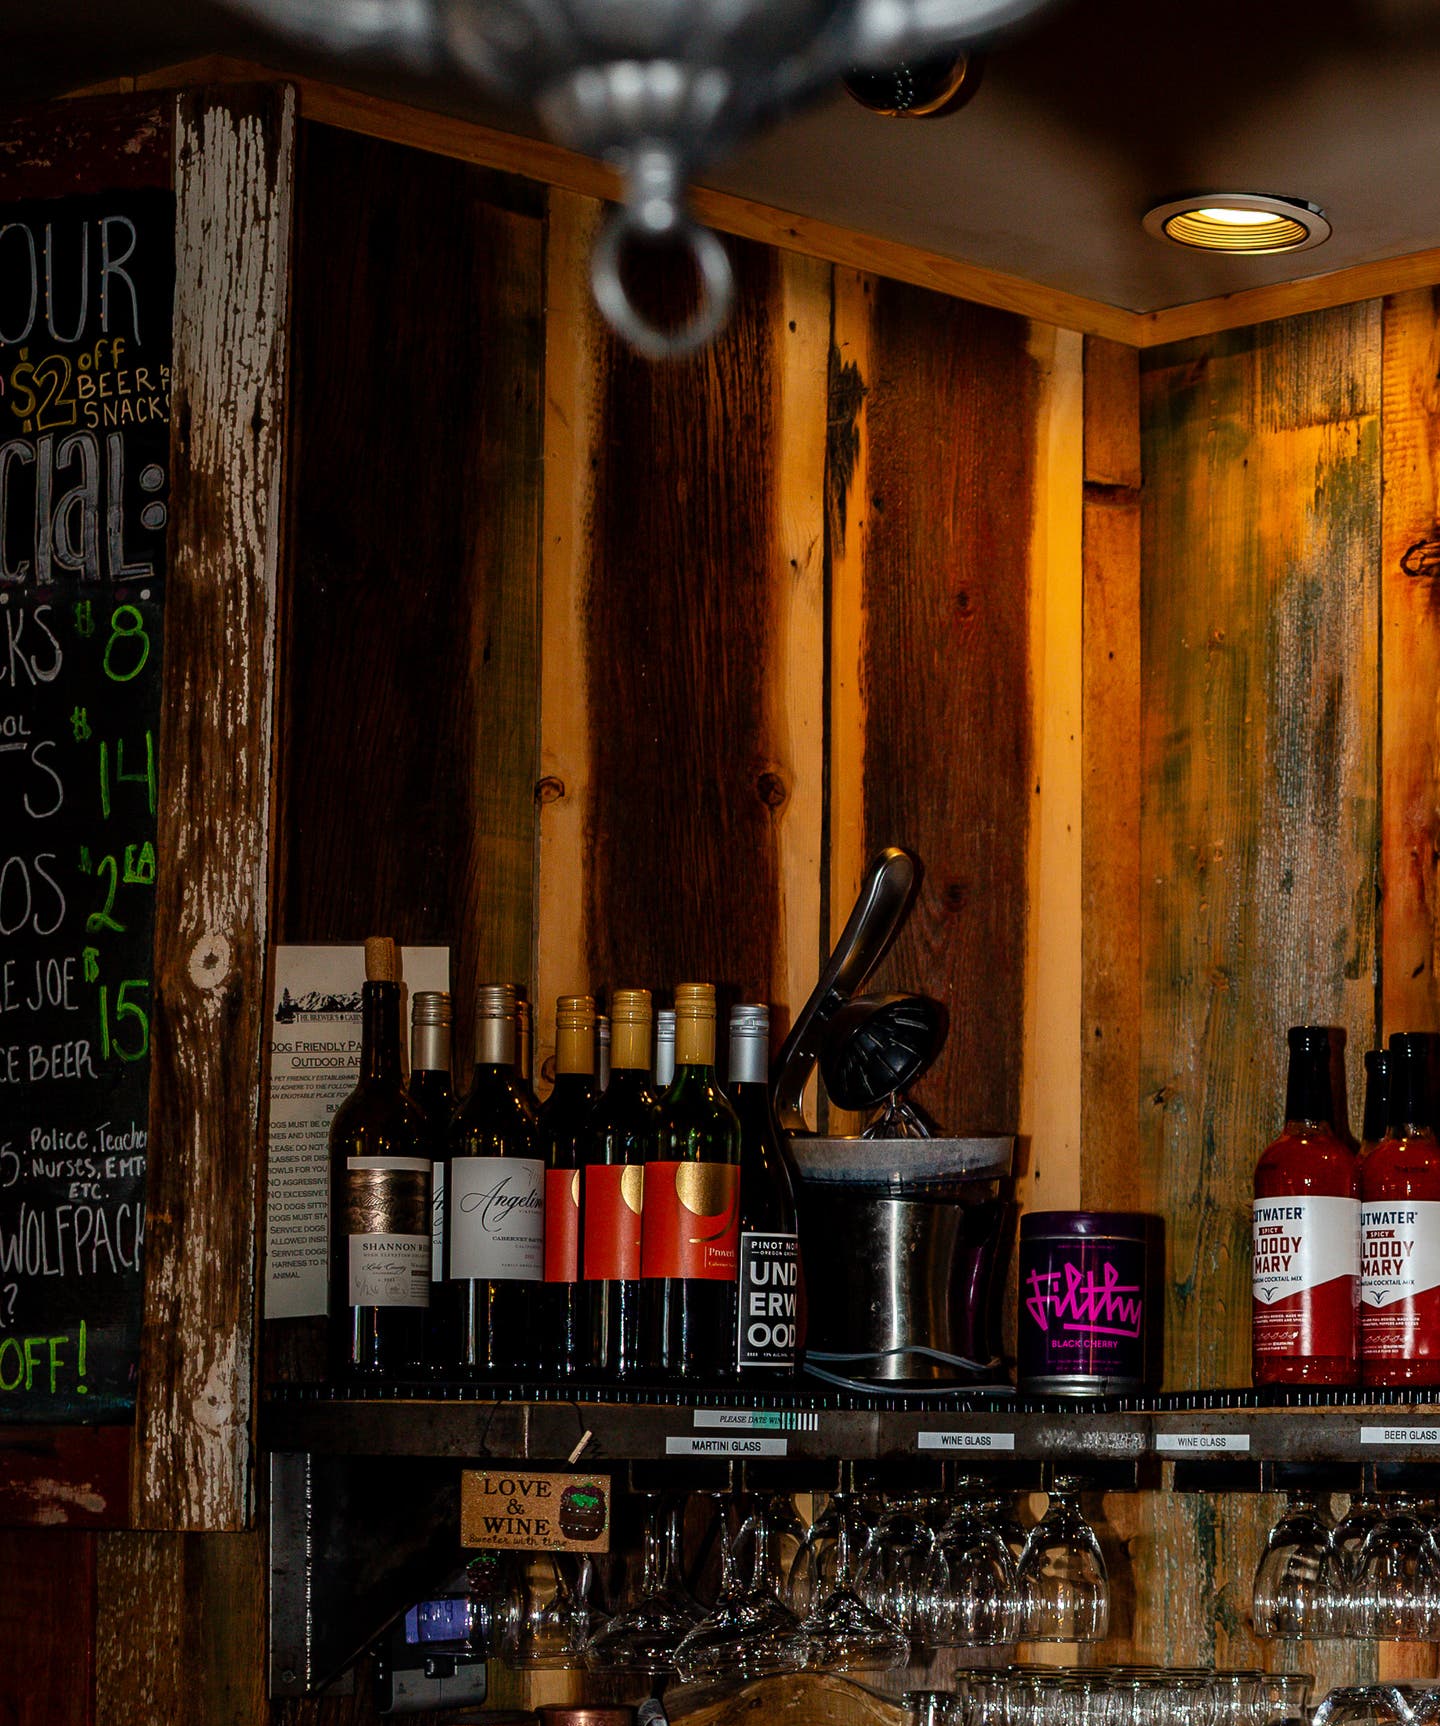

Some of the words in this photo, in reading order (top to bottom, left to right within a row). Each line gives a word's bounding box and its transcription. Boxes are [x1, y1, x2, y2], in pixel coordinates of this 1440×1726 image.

[78, 368, 156, 400] BEER
[295, 1041, 347, 1052] FRIENDLY
[29, 1039, 99, 1083] BEER
[291, 1056, 345, 1067] OUTDOOR
[68, 1180, 111, 1199] ETC.
[362, 1242, 417, 1251] SHANNON
[751, 1240, 783, 1250] PINOT
[1362, 1241, 1414, 1258] LOODY
[1255, 1256, 1291, 1273] MARY
[1361, 1259, 1402, 1276] MARY
[750, 1261, 797, 1286] UND
[1051, 1339, 1081, 1348] BLACK
[1083, 1339, 1119, 1349] CHERRY
[0, 1318, 88, 1395] OFF!
[720, 1415, 747, 1423] PLEASE
[748, 1416, 767, 1424] DATE
[941, 1435, 964, 1446] WINE
[965, 1435, 991, 1446] GLASS
[1177, 1437, 1198, 1447] WINE
[1200, 1437, 1226, 1447] GLASS
[1384, 1430, 1407, 1440] BEER
[1409, 1430, 1437, 1440] GLASS
[691, 1440, 730, 1452] MARTINI
[731, 1440, 761, 1452] GLASS
[483, 1478, 551, 1498] LOVE
[506, 1498, 525, 1515] &
[482, 1516, 551, 1536] WINE
[513, 1535, 538, 1547] with
